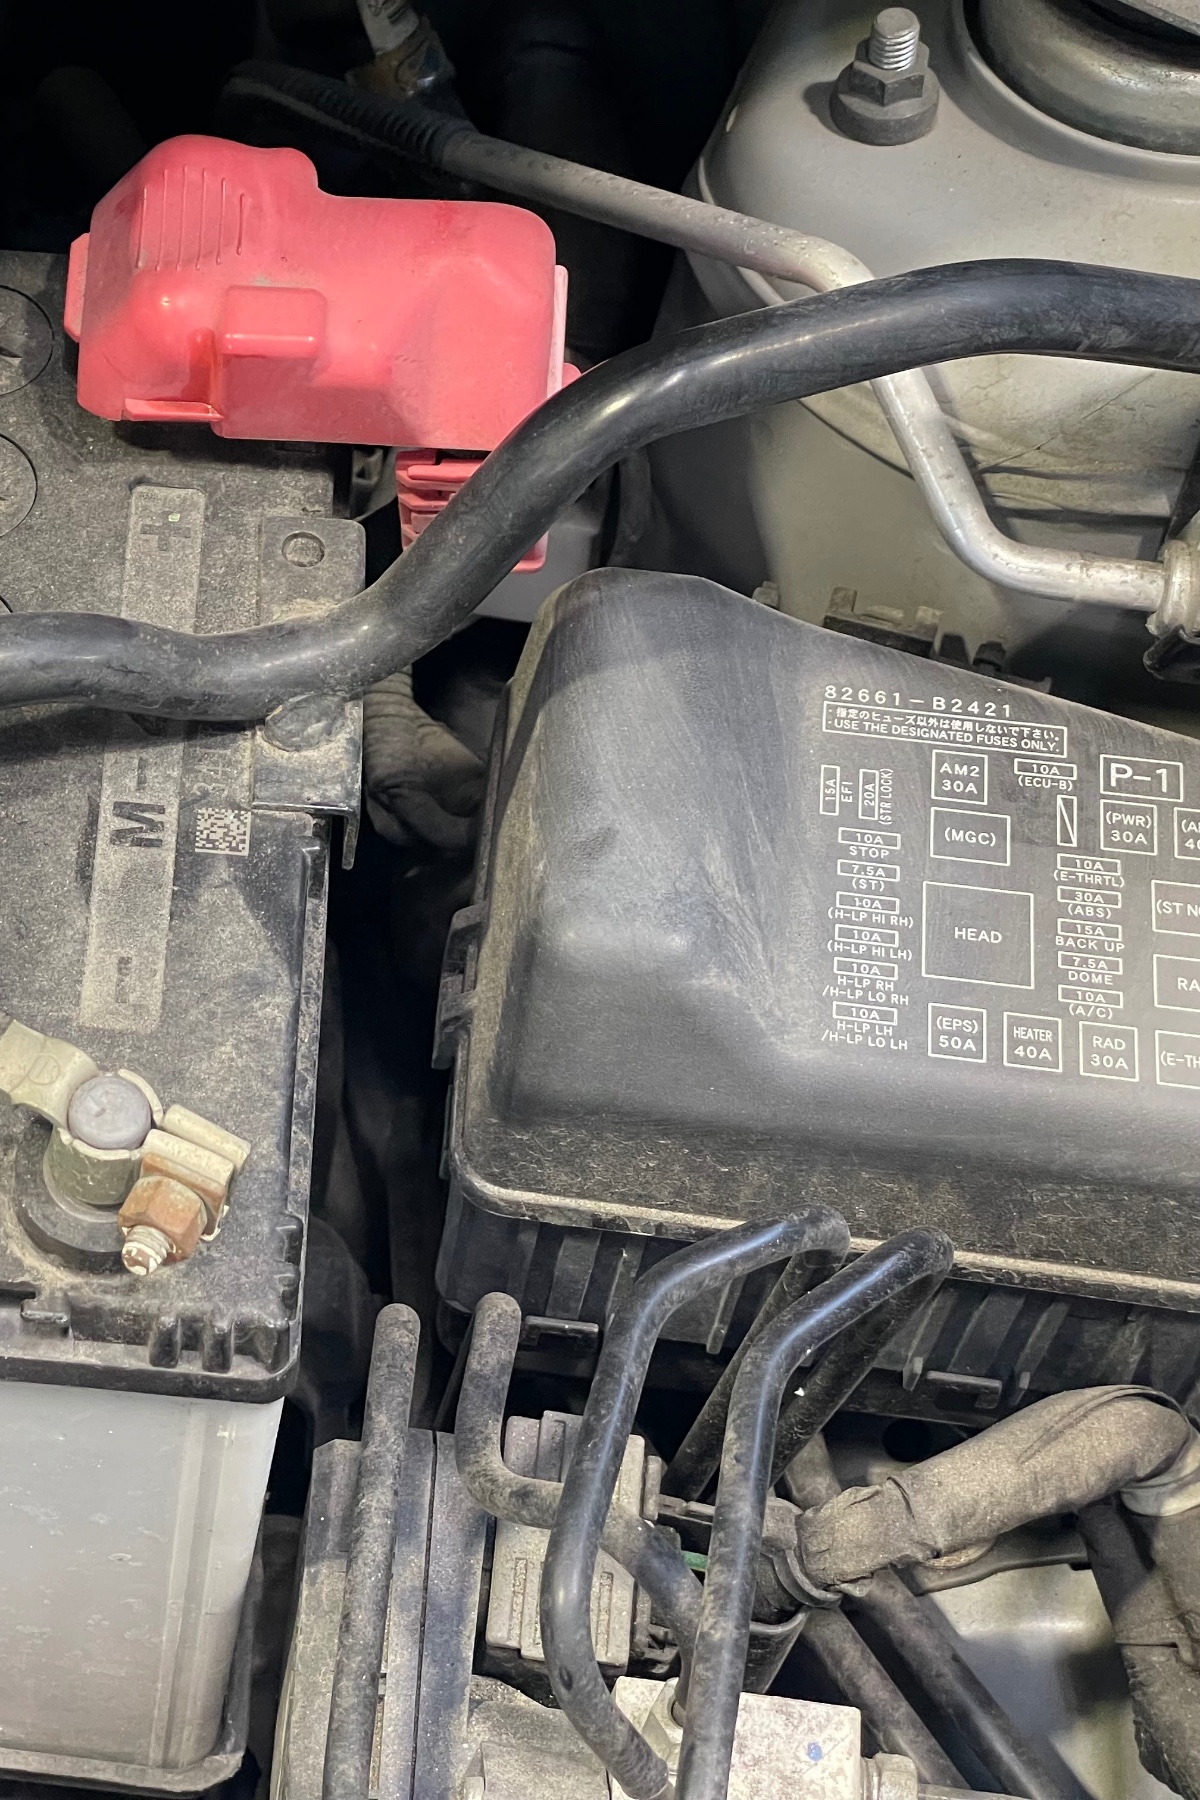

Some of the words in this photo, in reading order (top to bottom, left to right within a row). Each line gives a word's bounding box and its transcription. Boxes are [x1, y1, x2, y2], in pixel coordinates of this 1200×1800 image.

[834, 718, 859, 731] USE
[863, 721, 890, 734] THE
[892, 724, 974, 743] DESIGNATED
[976, 733, 1018, 748] FUSES
[1021, 738, 1061, 753] ONLY.
[939, 762, 980, 777] AM2
[1032, 763, 1061, 776] 10A
[880, 768, 894, 799] LOCK)
[1018, 775, 1074, 791] (ECU-B)
[1109, 763, 1168, 793] P-1
[825, 778, 837, 801] 15A
[841, 781, 853, 803] EFI
[864, 783, 875, 807] 20A
[941, 780, 978, 794] 30A
[878, 800, 893, 825] (STR
[1106, 811, 1152, 829] (PWR)
[1181, 819, 1200, 833] (A
[856, 832, 884, 845] 10A
[944, 827, 996, 847] (MGC)
[1110, 829, 1148, 845] 30A
[849, 845, 889, 859] STOP
[851, 864, 886, 877] 7.5A
[1075, 859, 1104, 872] 10A
[852, 878, 885, 892] (ST)
[1053, 869, 1125, 888] (E-THRTL)
[854, 897, 882, 910] 10A
[1075, 892, 1105, 904] 30A
[1067, 903, 1112, 919] (ABS)
[1156, 899, 1184, 915] (ST
[1187, 904, 1200, 917] N
[827, 906, 868, 921] (H-LP
[872, 913, 886, 924] HI
[890, 915, 914, 929] RH)
[853, 930, 882, 942] 10A
[954, 926, 1002, 945] HEAD
[1075, 924, 1105, 937] 15A
[827, 939, 867, 954] (H-LP
[871, 946, 885, 957] HI
[890, 948, 913, 961] LH)
[1055, 936, 1098, 950] BACK
[1104, 941, 1126, 952] UP
[851, 963, 881, 975] 10A
[1073, 956, 1108, 970] 7.5A
[837, 975, 871, 988] H-LP
[876, 980, 894, 992] RH
[1068, 970, 1114, 986] DOME
[822, 985, 864, 999] /H-LP
[868, 991, 886, 1002] LO
[890, 994, 909, 1005] RH
[1076, 991, 1106, 1003] 10A
[851, 1008, 880, 1020] 10A
[1069, 1003, 1113, 1020] (A/C)
[837, 1020, 871, 1033] H-LP
[875, 1025, 893, 1036] LH
[936, 1017, 979, 1034] (EPS)
[821, 1029, 863, 1044] /H-LP
[868, 1036, 886, 1047] LO
[890, 1039, 908, 1050] LH
[1013, 1026, 1053, 1043] HEATER
[938, 1035, 976, 1052] 50A
[1092, 1035, 1126, 1051] RAD
[1013, 1044, 1052, 1062] 40A
[1090, 1053, 1129, 1070] 30A
